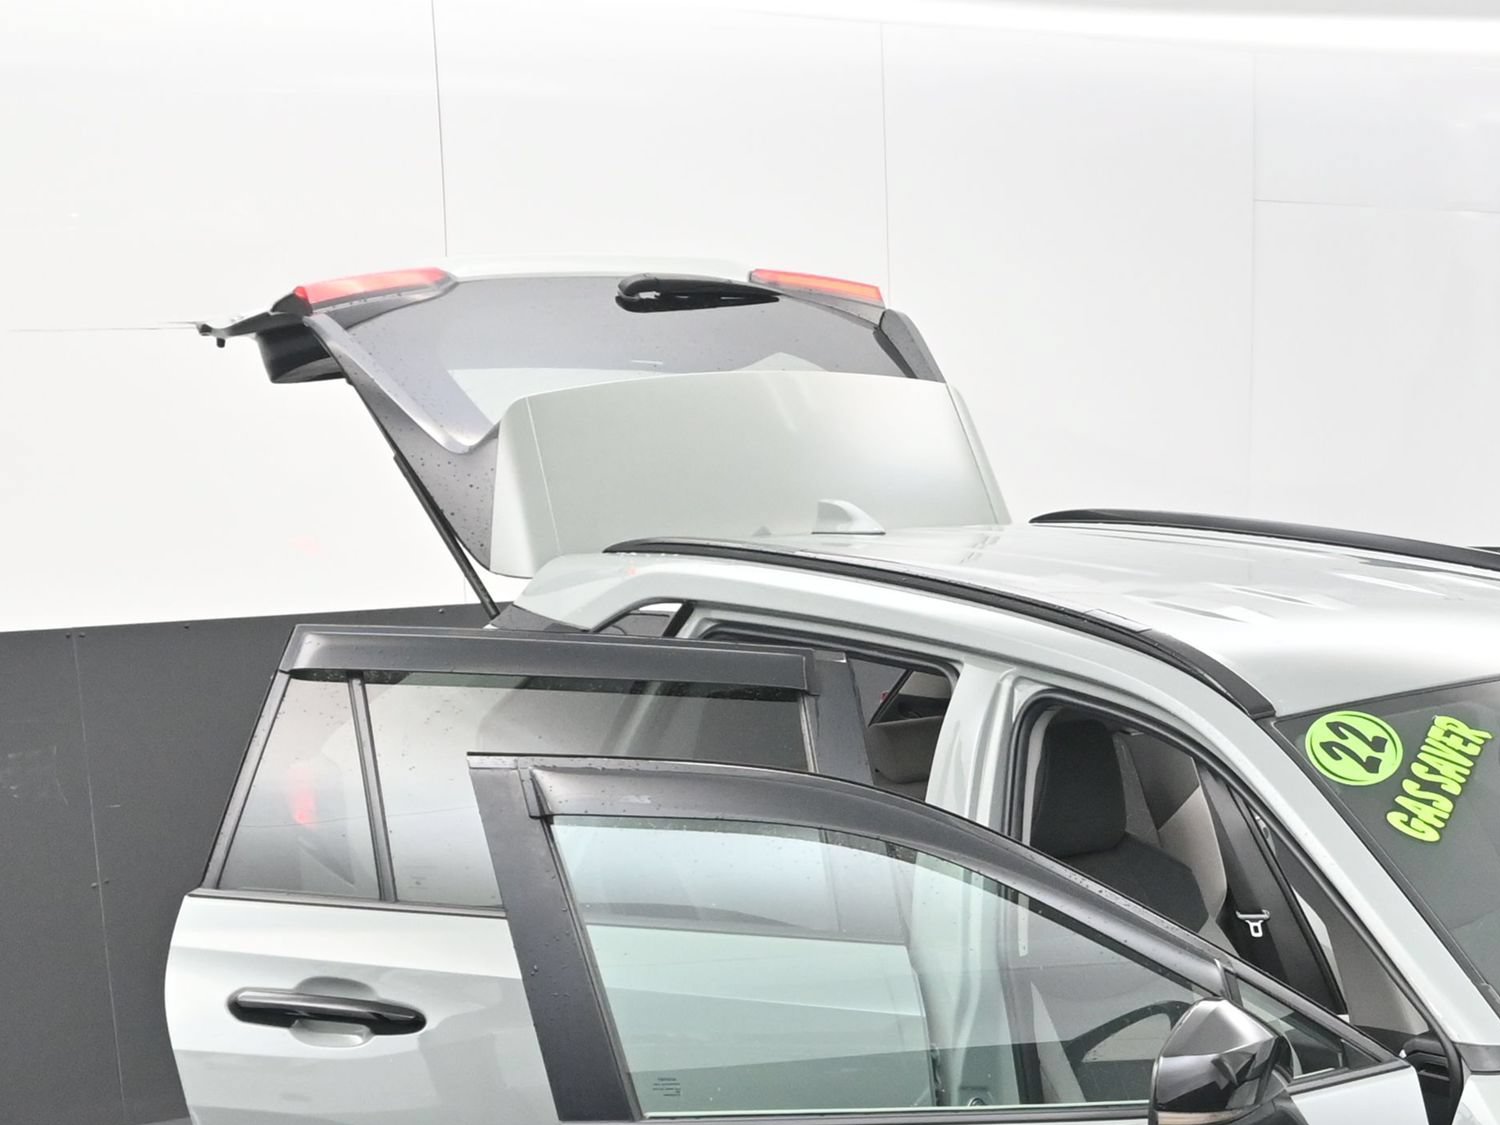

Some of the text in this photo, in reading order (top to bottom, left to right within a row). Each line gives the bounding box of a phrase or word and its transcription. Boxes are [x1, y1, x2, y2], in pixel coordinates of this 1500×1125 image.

[1318, 720, 1389, 775] 22
[1385, 715, 1494, 842] GAS SAVER
